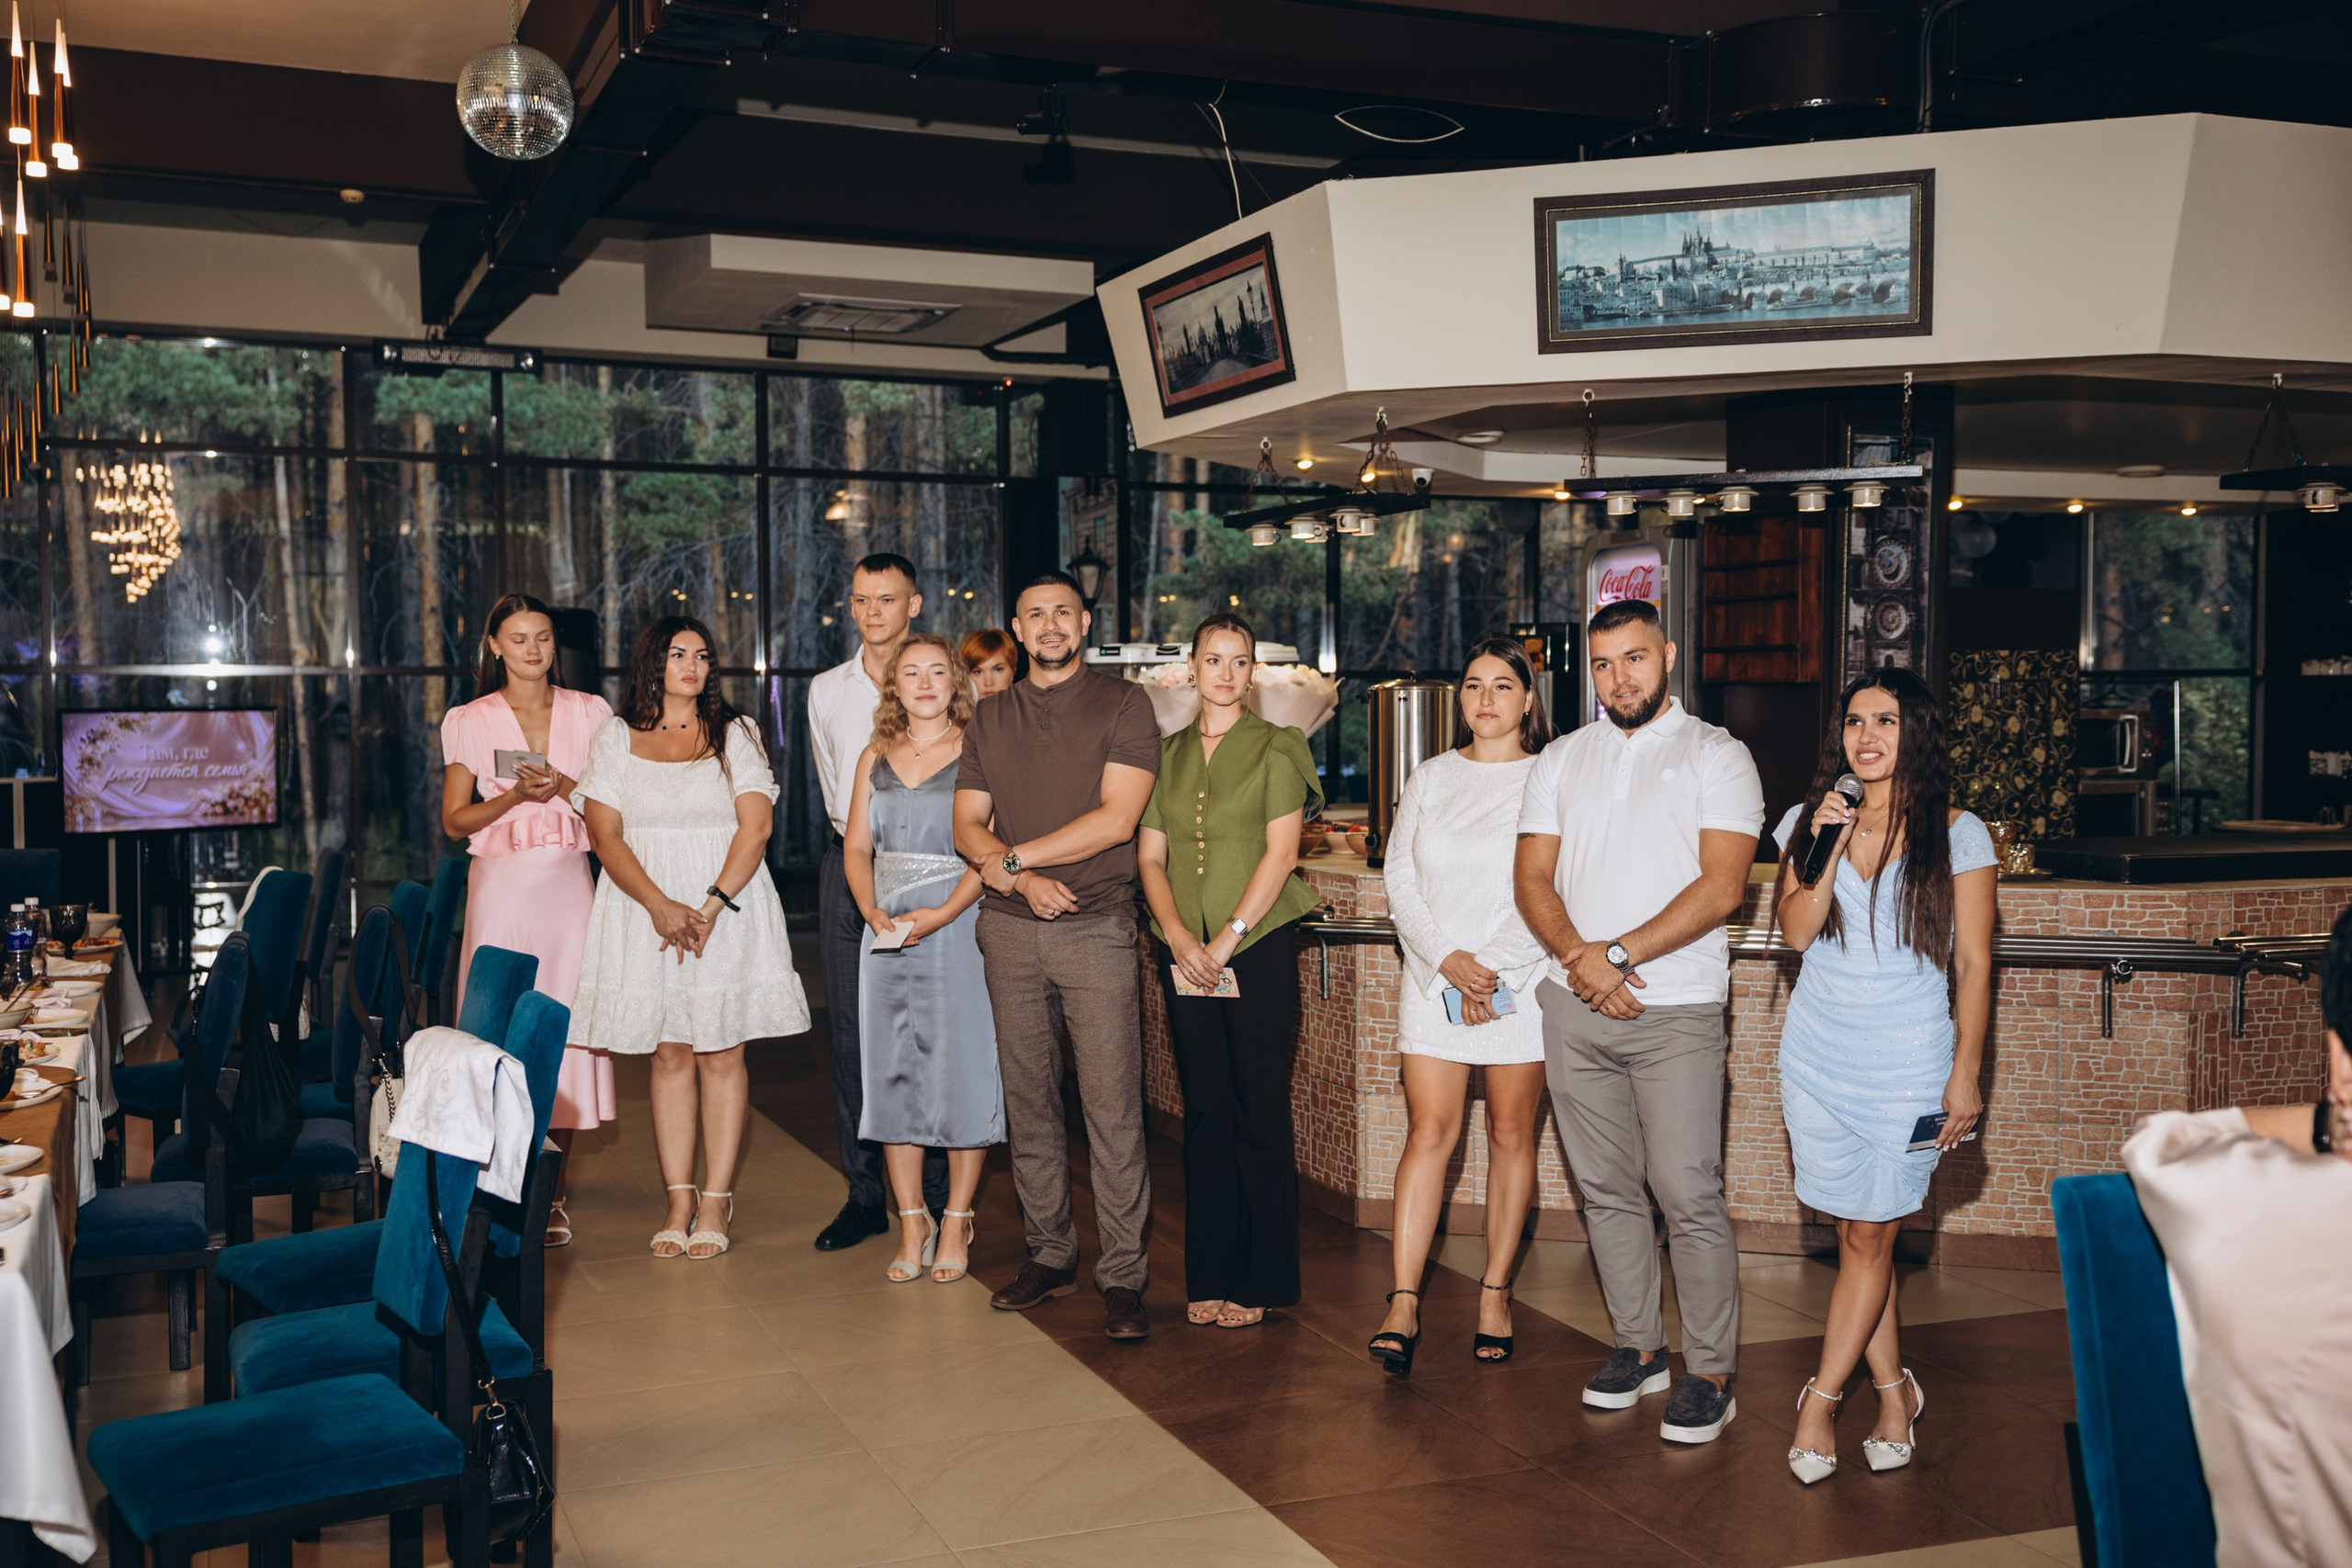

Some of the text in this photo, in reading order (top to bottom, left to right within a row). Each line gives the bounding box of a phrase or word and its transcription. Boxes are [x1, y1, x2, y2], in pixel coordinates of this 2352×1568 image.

[140, 743, 209, 763] Там, где
[99, 762, 247, 796] рождается семья
